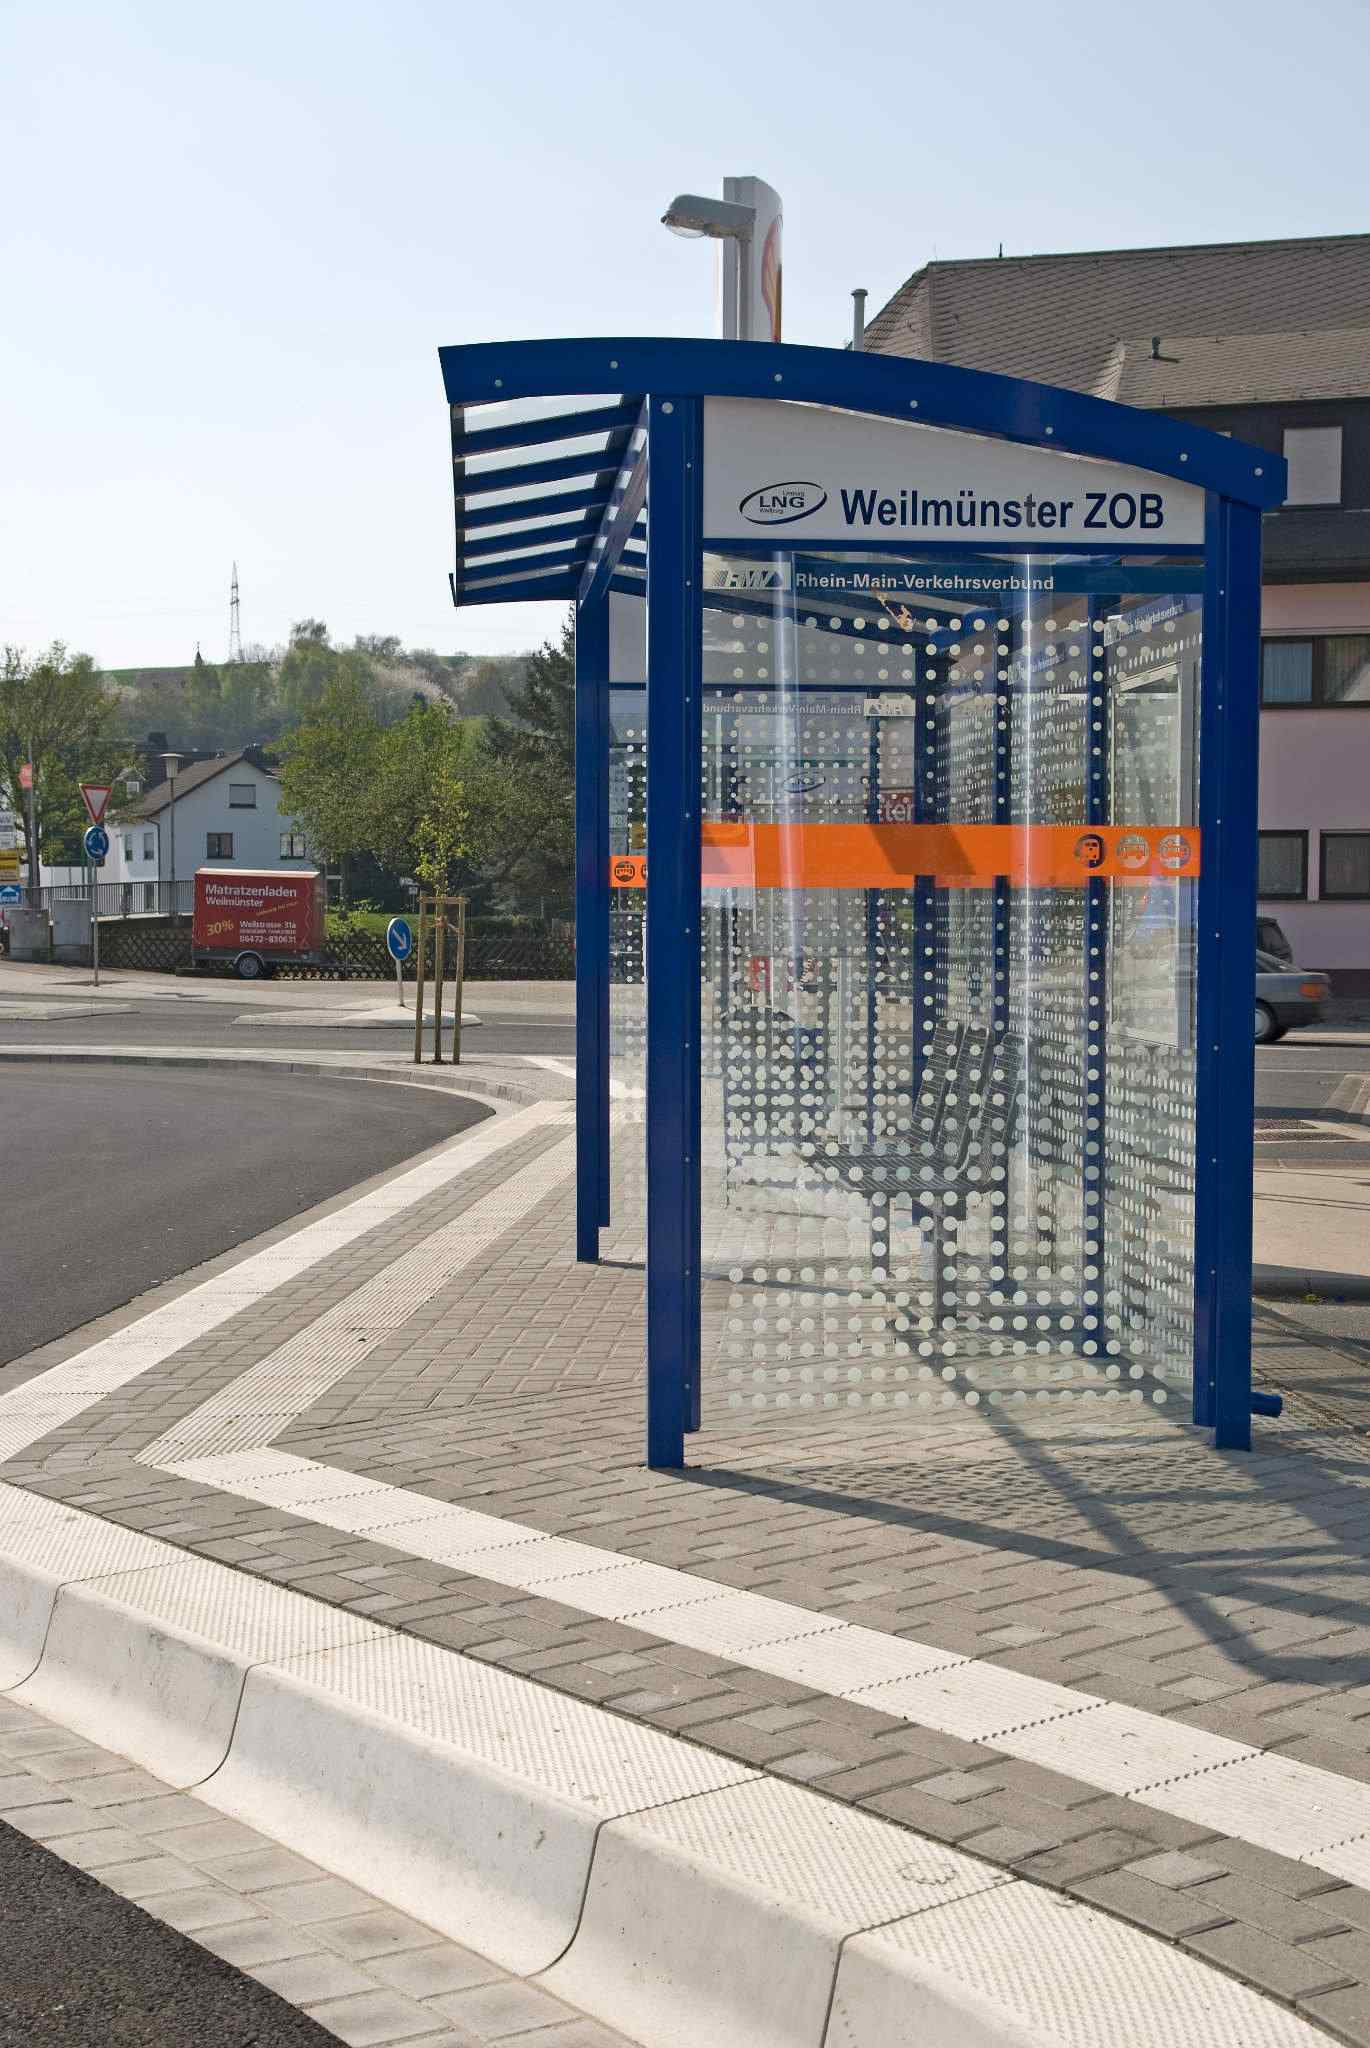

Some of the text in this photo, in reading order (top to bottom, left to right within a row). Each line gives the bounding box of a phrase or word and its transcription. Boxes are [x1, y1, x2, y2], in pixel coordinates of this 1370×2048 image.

[760, 496, 804, 508] LNG
[840, 488, 1164, 529] Weilmünster ZOB
[796, 572, 1054, 590] Rhein-Main-Verkehrsverbund
[205, 884, 297, 897] Matratzenladen
[205, 897, 264, 908] Weilmünster
[206, 920, 235, 937] 30%
